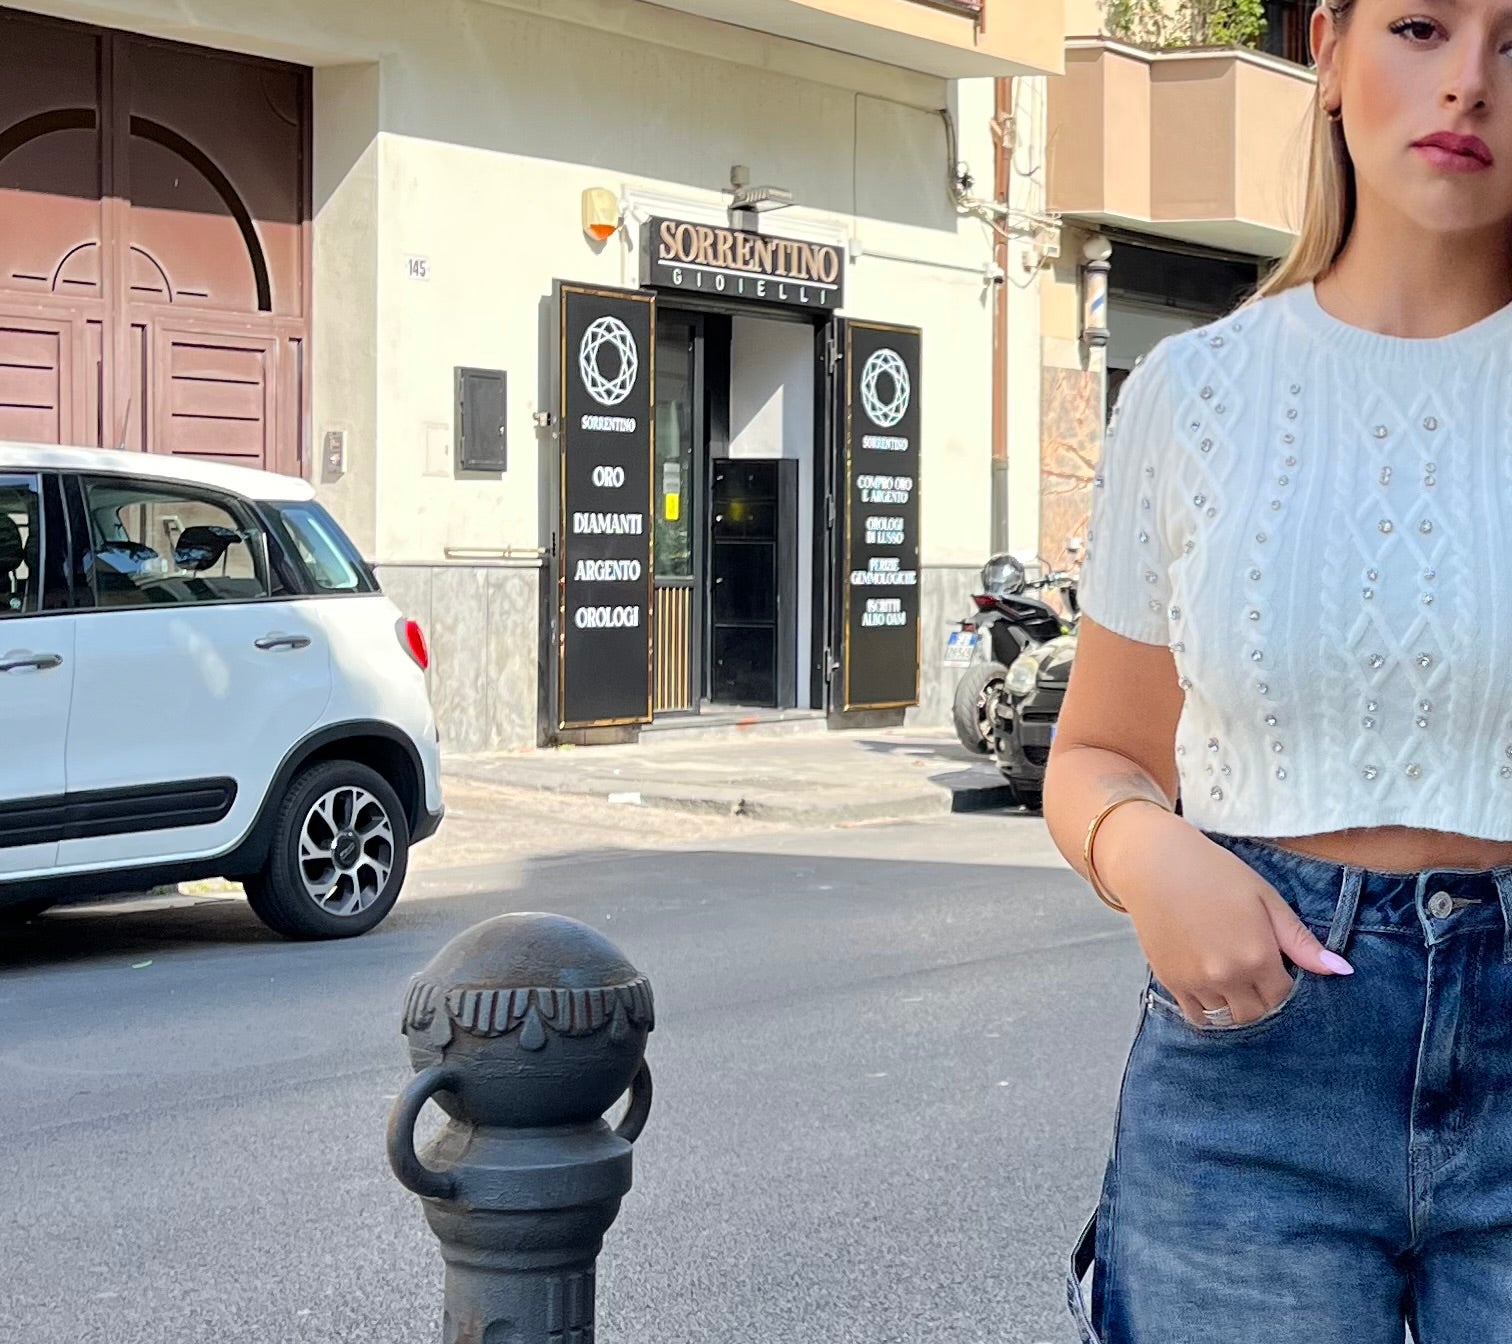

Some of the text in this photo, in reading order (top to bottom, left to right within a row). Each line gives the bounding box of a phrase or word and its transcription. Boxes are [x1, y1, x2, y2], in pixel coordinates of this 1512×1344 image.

[659, 220, 839, 283] SORRENTINO
[409, 258, 426, 277] 145
[673, 268, 826, 305] GIOIELLI
[581, 415, 636, 433] SORRENTINO
[592, 465, 625, 488] ORO
[894, 477, 913, 491] ORO
[573, 512, 643, 534] DIAMANTI
[865, 517, 904, 531] OROLOGI
[877, 531, 905, 545] LUSSO
[574, 560, 641, 581] ARGENTO
[575, 606, 640, 628] OROLOGI
